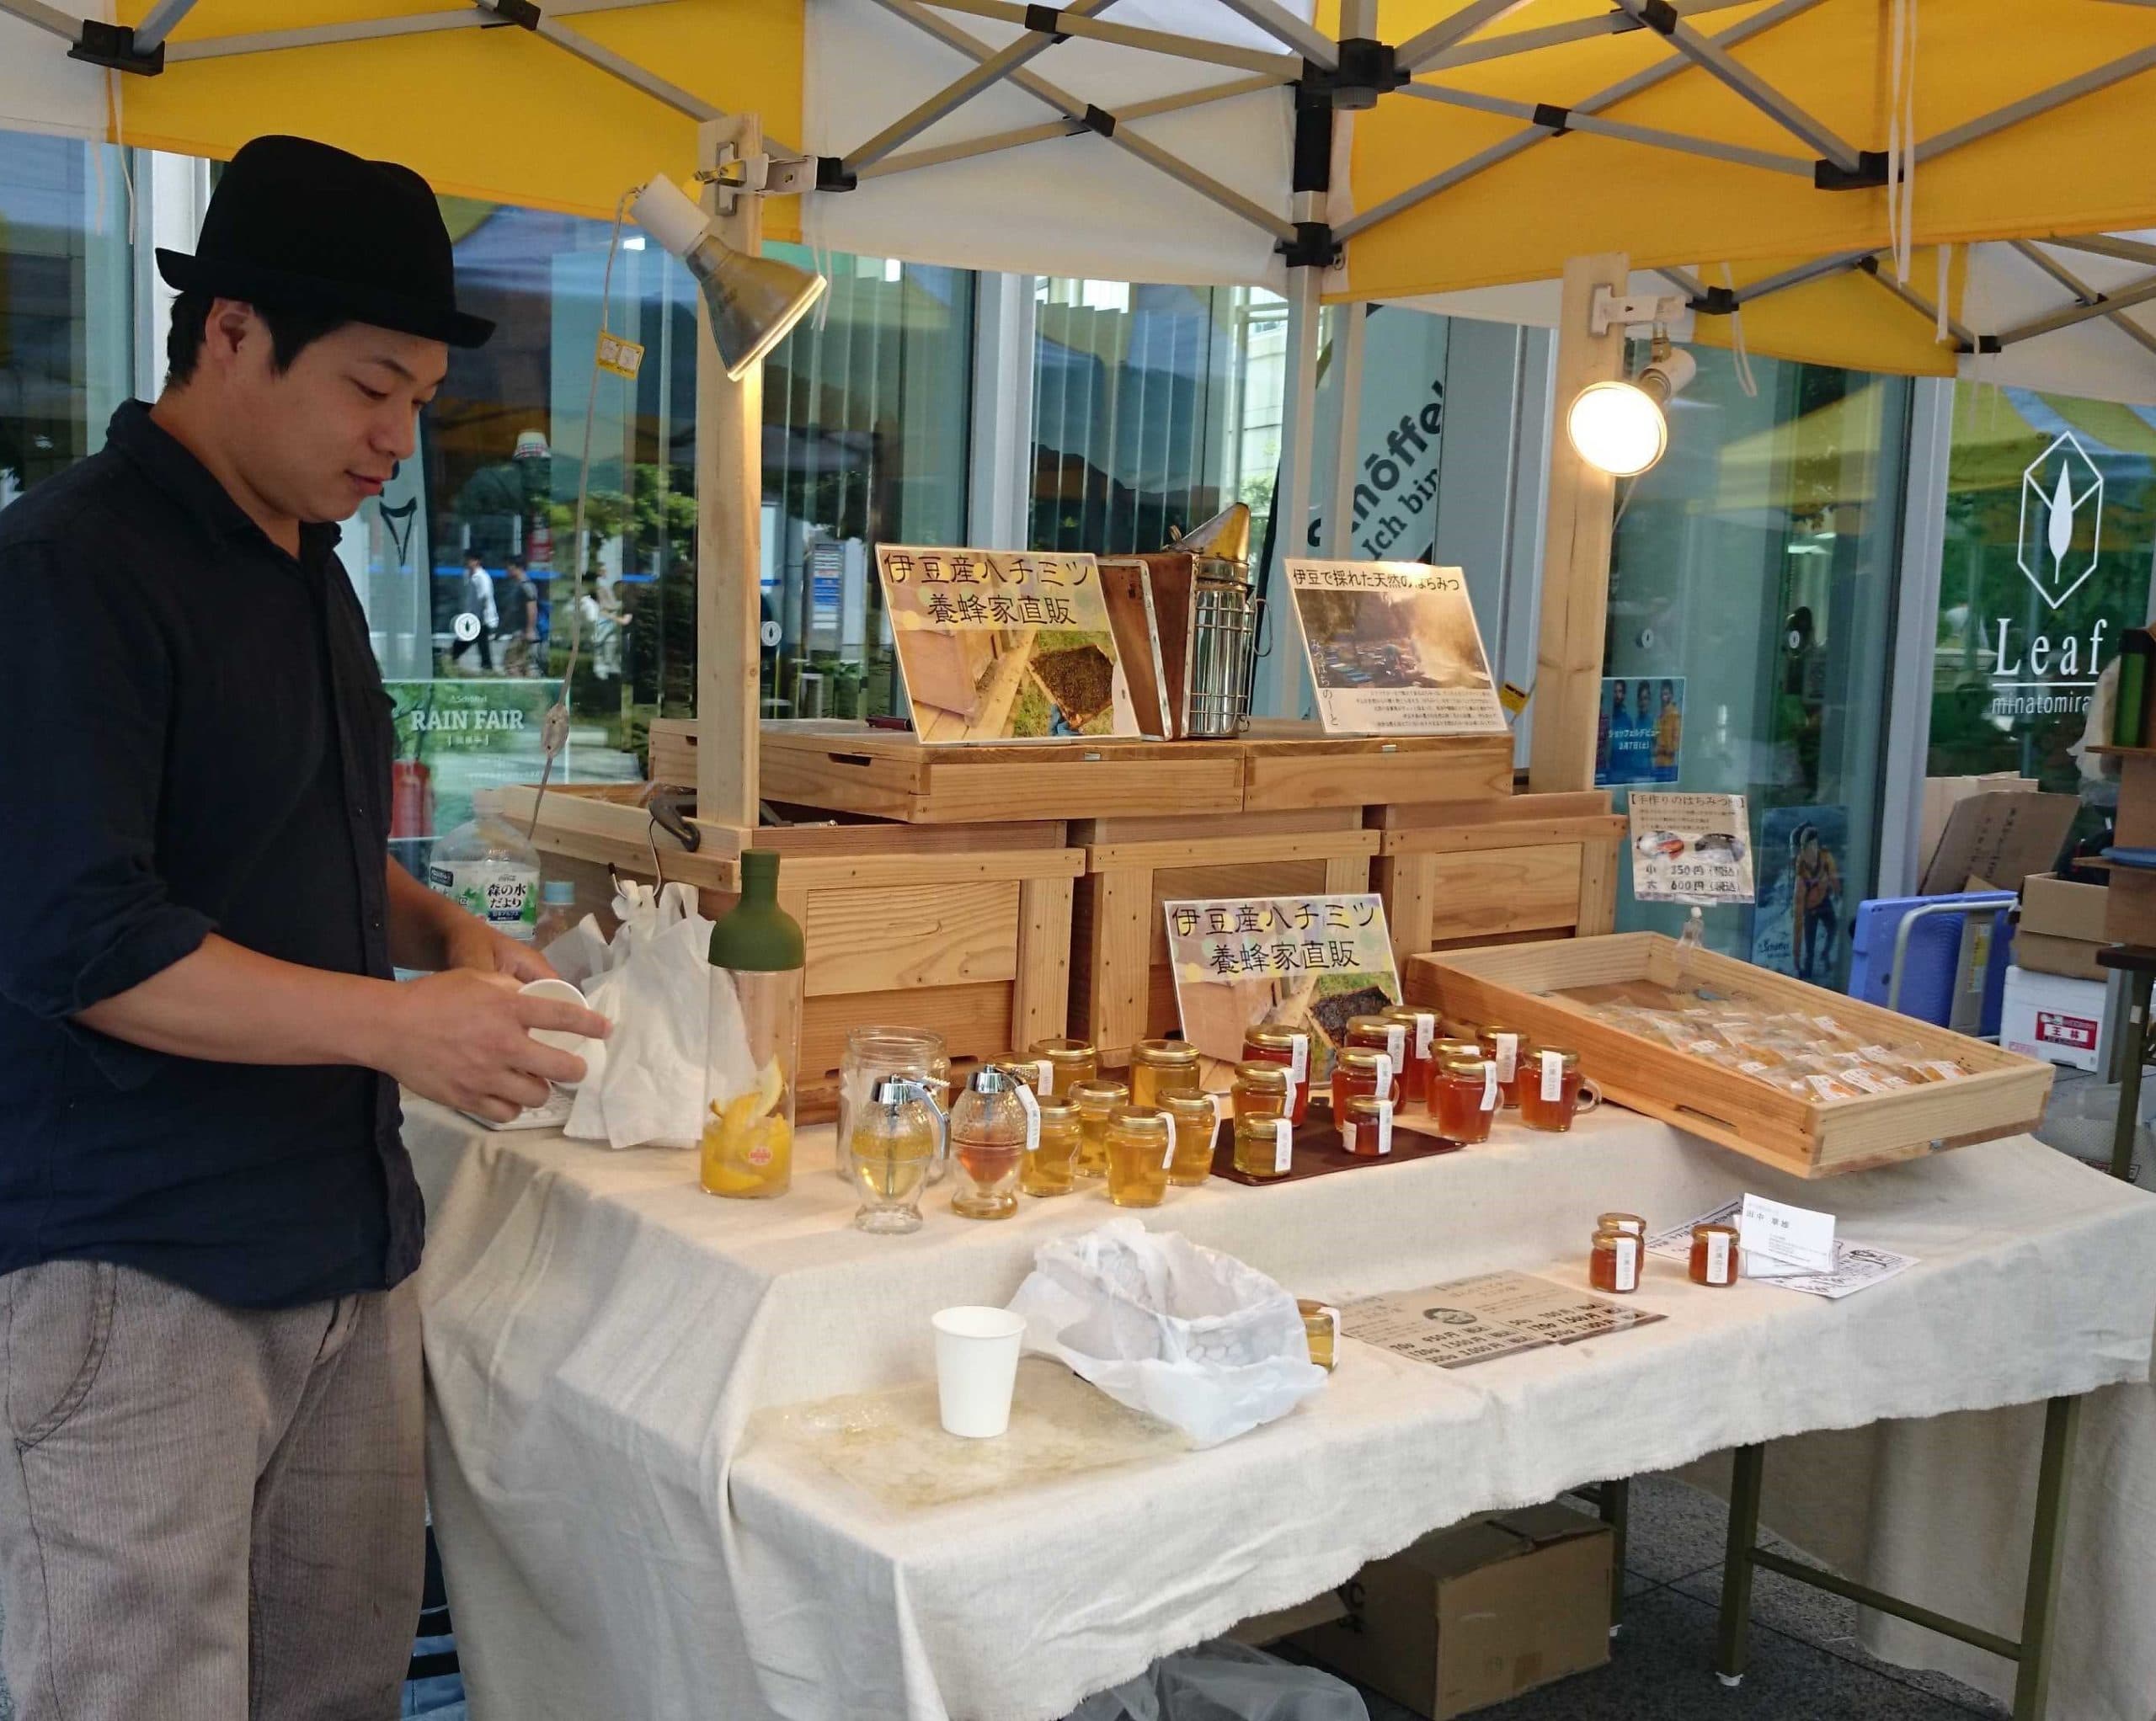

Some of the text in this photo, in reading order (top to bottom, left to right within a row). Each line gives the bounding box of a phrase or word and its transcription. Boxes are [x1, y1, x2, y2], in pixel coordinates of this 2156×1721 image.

[1361, 515, 1408, 561] Ich
[883, 553, 1089, 587] 伊豆産ハチミツ
[927, 593, 1078, 626] 養蜂家直販
[1993, 618, 2108, 676] Leaf
[1991, 690, 2093, 715] minatomira
[410, 708, 526, 732] RAIN FAIR
[488, 882, 527, 897] 森の水
[490, 898, 522, 908] だより
[1171, 902, 1374, 937] 伊豆産ハチミツ
[1210, 940, 1360, 975] 養蜂家直販
